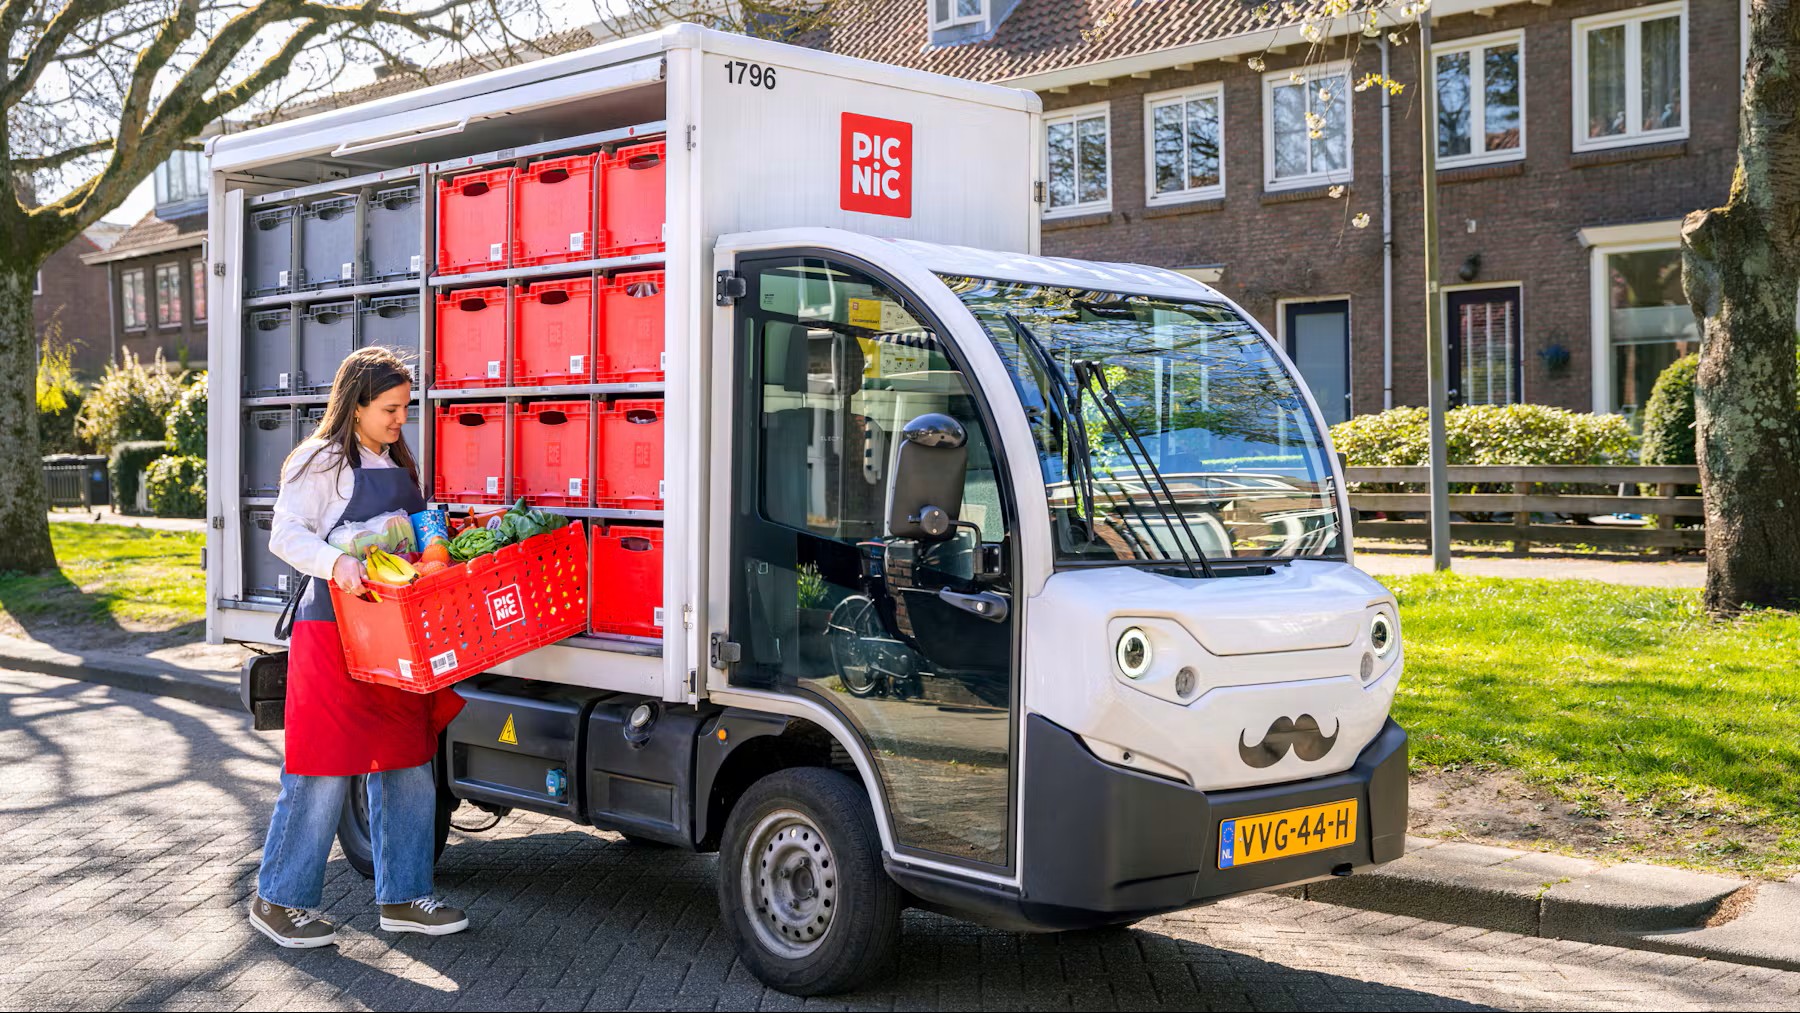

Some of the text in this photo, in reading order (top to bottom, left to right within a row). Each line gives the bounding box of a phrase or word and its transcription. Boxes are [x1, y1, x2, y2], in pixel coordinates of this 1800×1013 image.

[724, 60, 776, 90] 1796
[853, 132, 902, 167] PIC
[493, 592, 515, 610] PIC
[1241, 807, 1349, 857] VVG-44-H
[1222, 849, 1232, 860] NL
